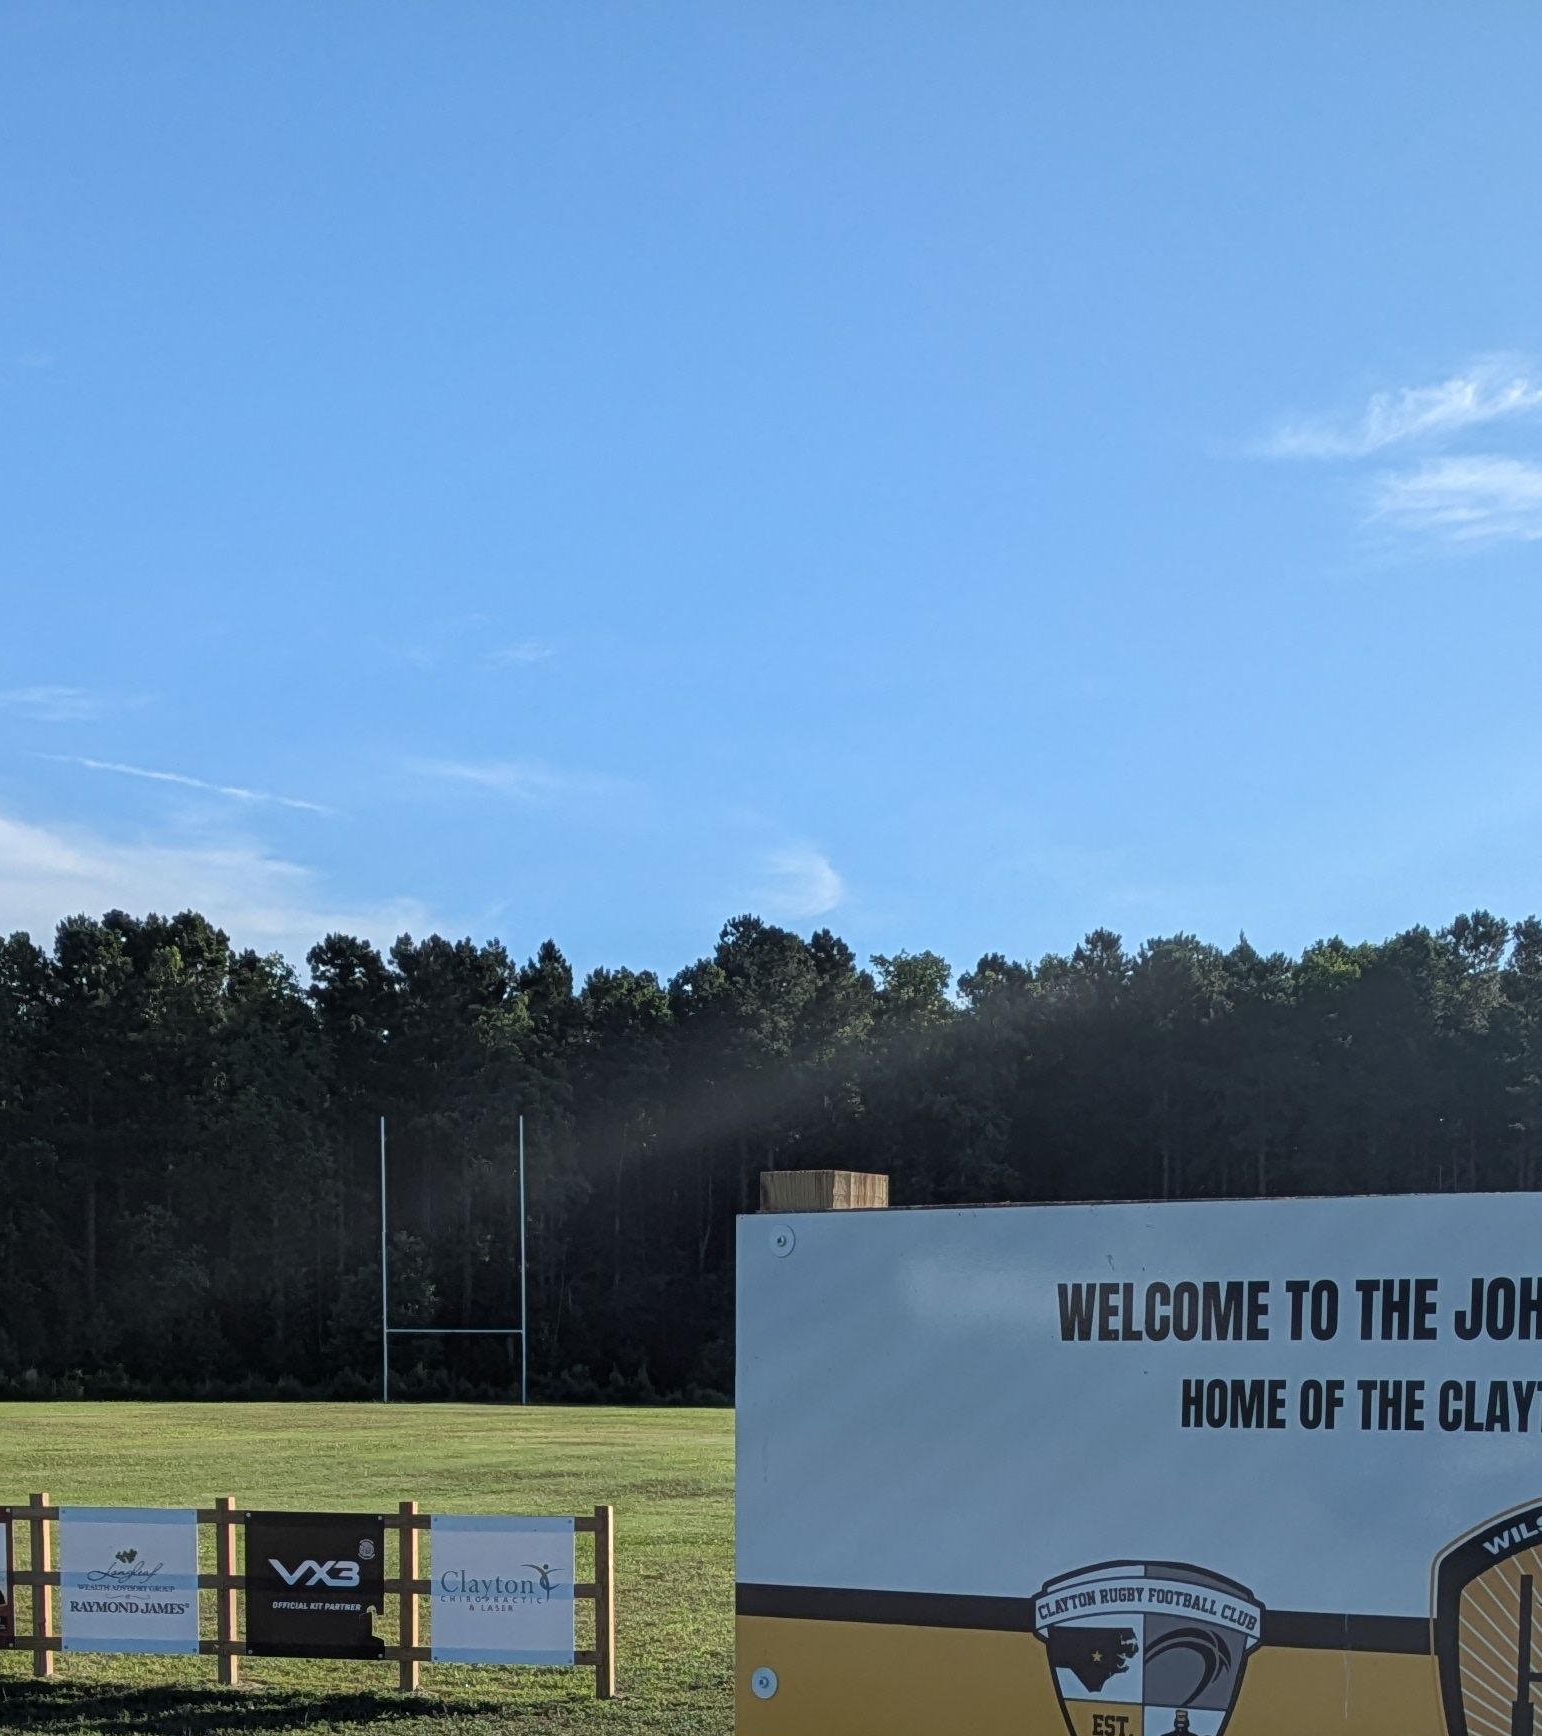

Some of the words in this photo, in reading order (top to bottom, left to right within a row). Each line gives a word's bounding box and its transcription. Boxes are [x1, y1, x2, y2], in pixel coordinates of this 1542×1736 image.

[1057, 1279, 1269, 1341] WELCOME
[1284, 1279, 1338, 1341] TO
[1355, 1278, 1438, 1341] THE
[1181, 1378, 1286, 1429] HOME
[1299, 1378, 1345, 1430] OF
[1357, 1379, 1425, 1431] THE
[267, 1558, 361, 1587] VX3
[440, 1569, 534, 1599] Clayton
[70, 1600, 139, 1614] RAYMOND
[272, 1601, 308, 1610] OFFICIAL
[309, 1602, 324, 1610] KIT
[324, 1602, 362, 1611] PARTNER
[440, 1595, 543, 1604] CHIROPRACTIC
[481, 1604, 514, 1612] LASER
[1037, 1591, 1097, 1619] CLAYTON
[1100, 1587, 1144, 1604] RUGBY
[1148, 1588, 1217, 1616] FOOTBALL
[1221, 1604, 1258, 1632] CLUB
